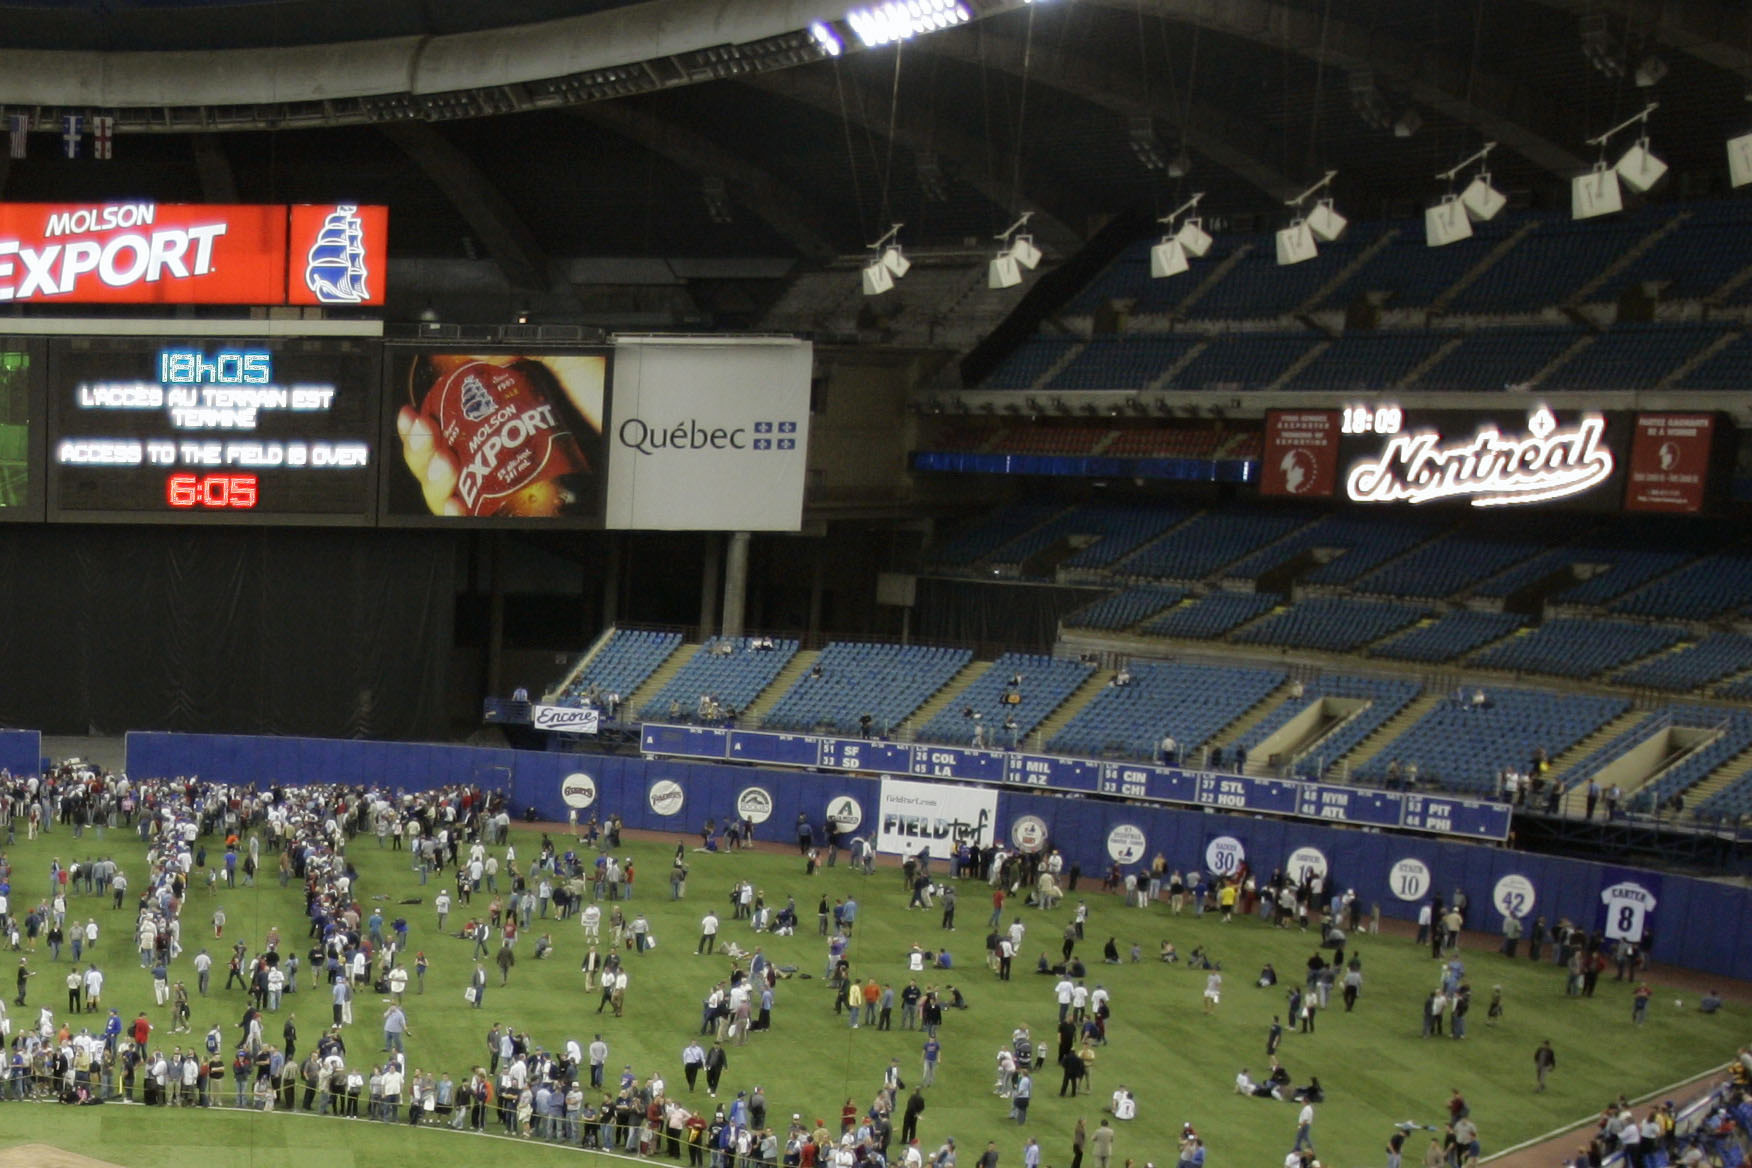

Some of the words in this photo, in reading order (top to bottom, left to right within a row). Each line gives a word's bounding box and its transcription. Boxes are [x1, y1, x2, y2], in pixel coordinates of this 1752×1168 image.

[45, 204, 155, 237] MOLSON
[161, 353, 270, 384] 18h05
[168, 387, 197, 407] AU
[202, 387, 287, 408] TERRAIN
[292, 387, 334, 409] EST
[1341, 408, 1402, 433] 18:09
[469, 404, 517, 453] MOLSON
[619, 418, 746, 455] Québec
[60, 444, 142, 463] ACCESS
[148, 444, 176, 464] TO
[181, 444, 222, 464] THE
[227, 445, 283, 465] FIELD
[288, 446, 307, 465] IS
[312, 446, 367, 466] OVER
[459, 405, 557, 509] EXPORT
[168, 477, 257, 507] 6:05
[537, 708, 597, 726] Encore
[844, 746, 859, 756] SF
[842, 758, 859, 768] SD
[932, 753, 956, 765] COL
[934, 766, 952, 776] LA
[1026, 761, 1051, 774] MIL
[1027, 774, 1048, 785] AZ
[1123, 771, 1146, 783] CIN
[1122, 784, 1145, 796] CHI
[1220, 781, 1245, 794] STL
[1218, 794, 1245, 807] HOU
[1322, 792, 1347, 806] NYM
[1321, 806, 1346, 819] ATL
[1429, 803, 1451, 816] PIT
[1427, 817, 1451, 830] PHI
[1215, 851, 1234, 871] 30
[1400, 875, 1419, 897] 10
[1503, 891, 1525, 912] 42
[1612, 888, 1646, 902] CARTER
[1618, 906, 1635, 932] 8
